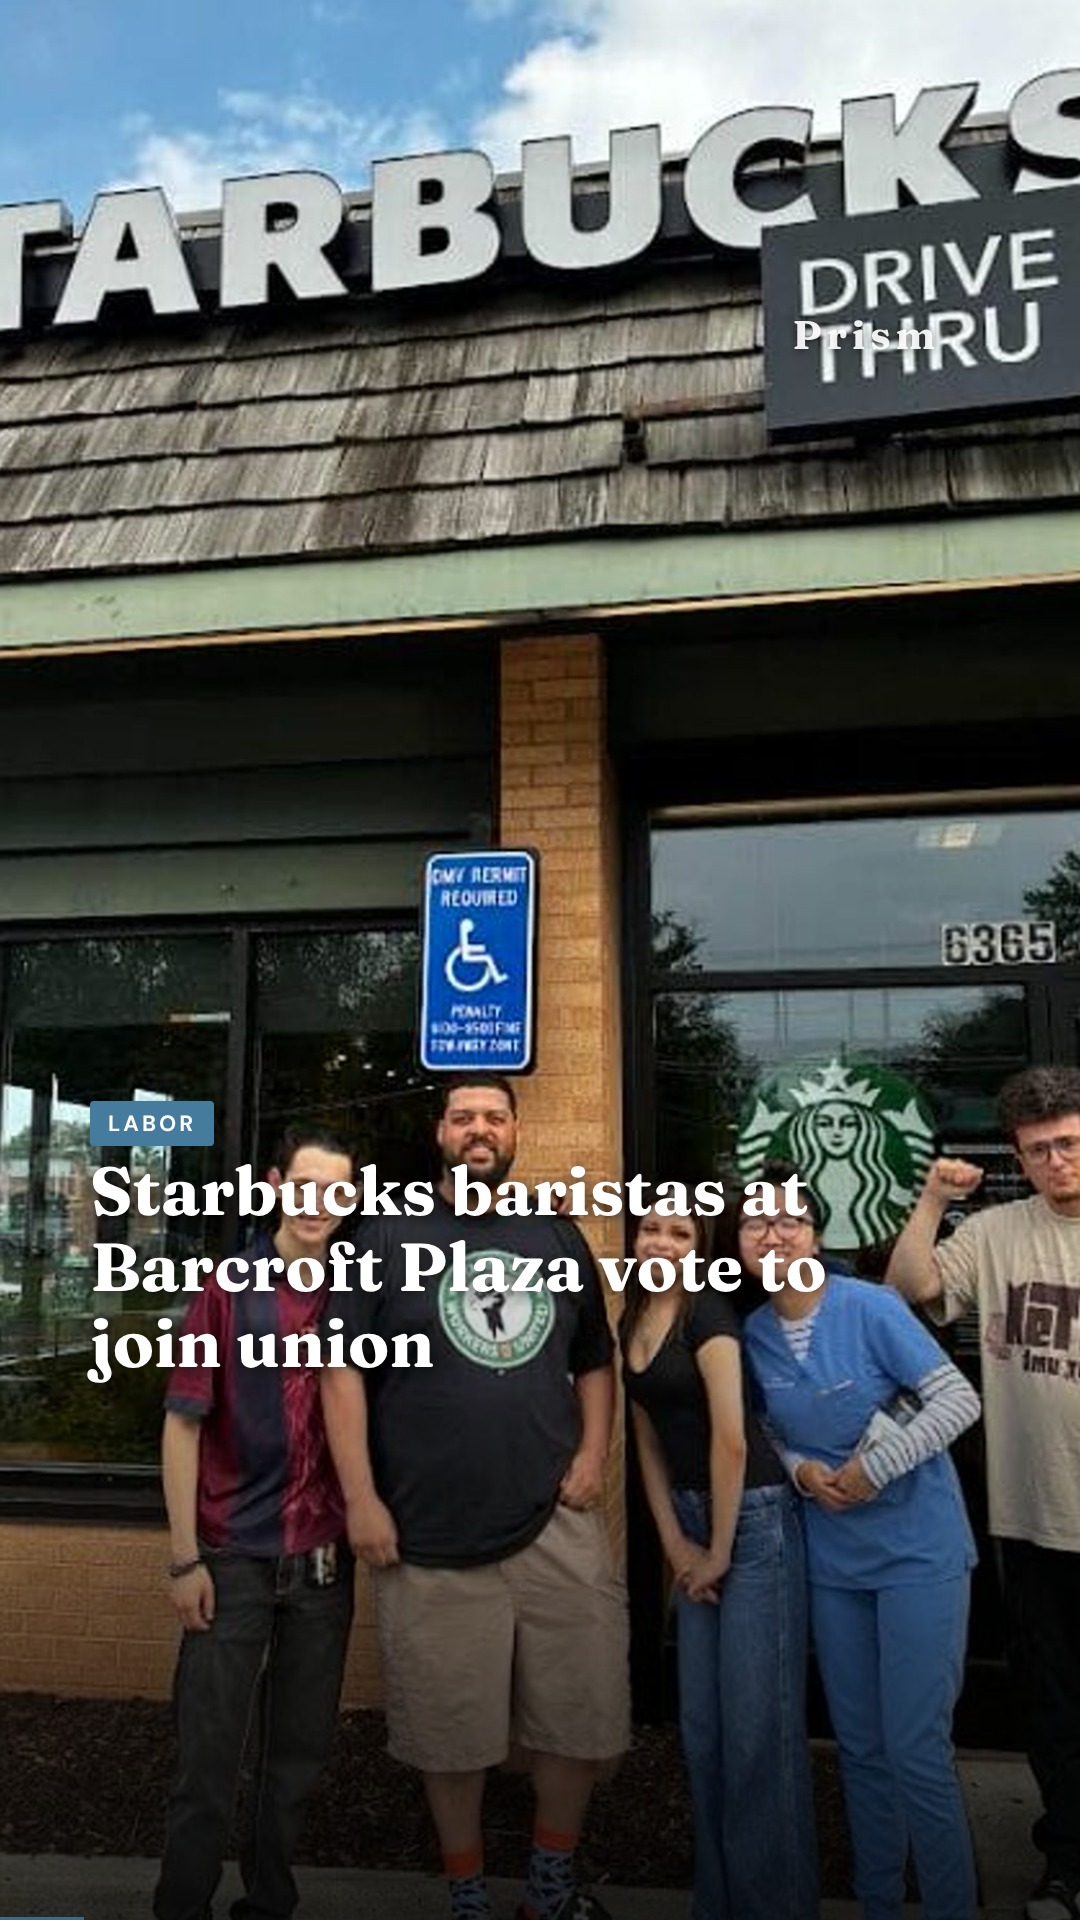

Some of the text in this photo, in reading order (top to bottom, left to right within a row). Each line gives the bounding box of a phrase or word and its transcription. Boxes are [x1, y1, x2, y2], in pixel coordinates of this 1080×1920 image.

[800, 229, 1059, 316] DRIVE
[804, 301, 1040, 383] THRU
[471, 866, 528, 884] PERMIT
[441, 889, 518, 908] REQUIRED
[945, 923, 1054, 963] 6365
